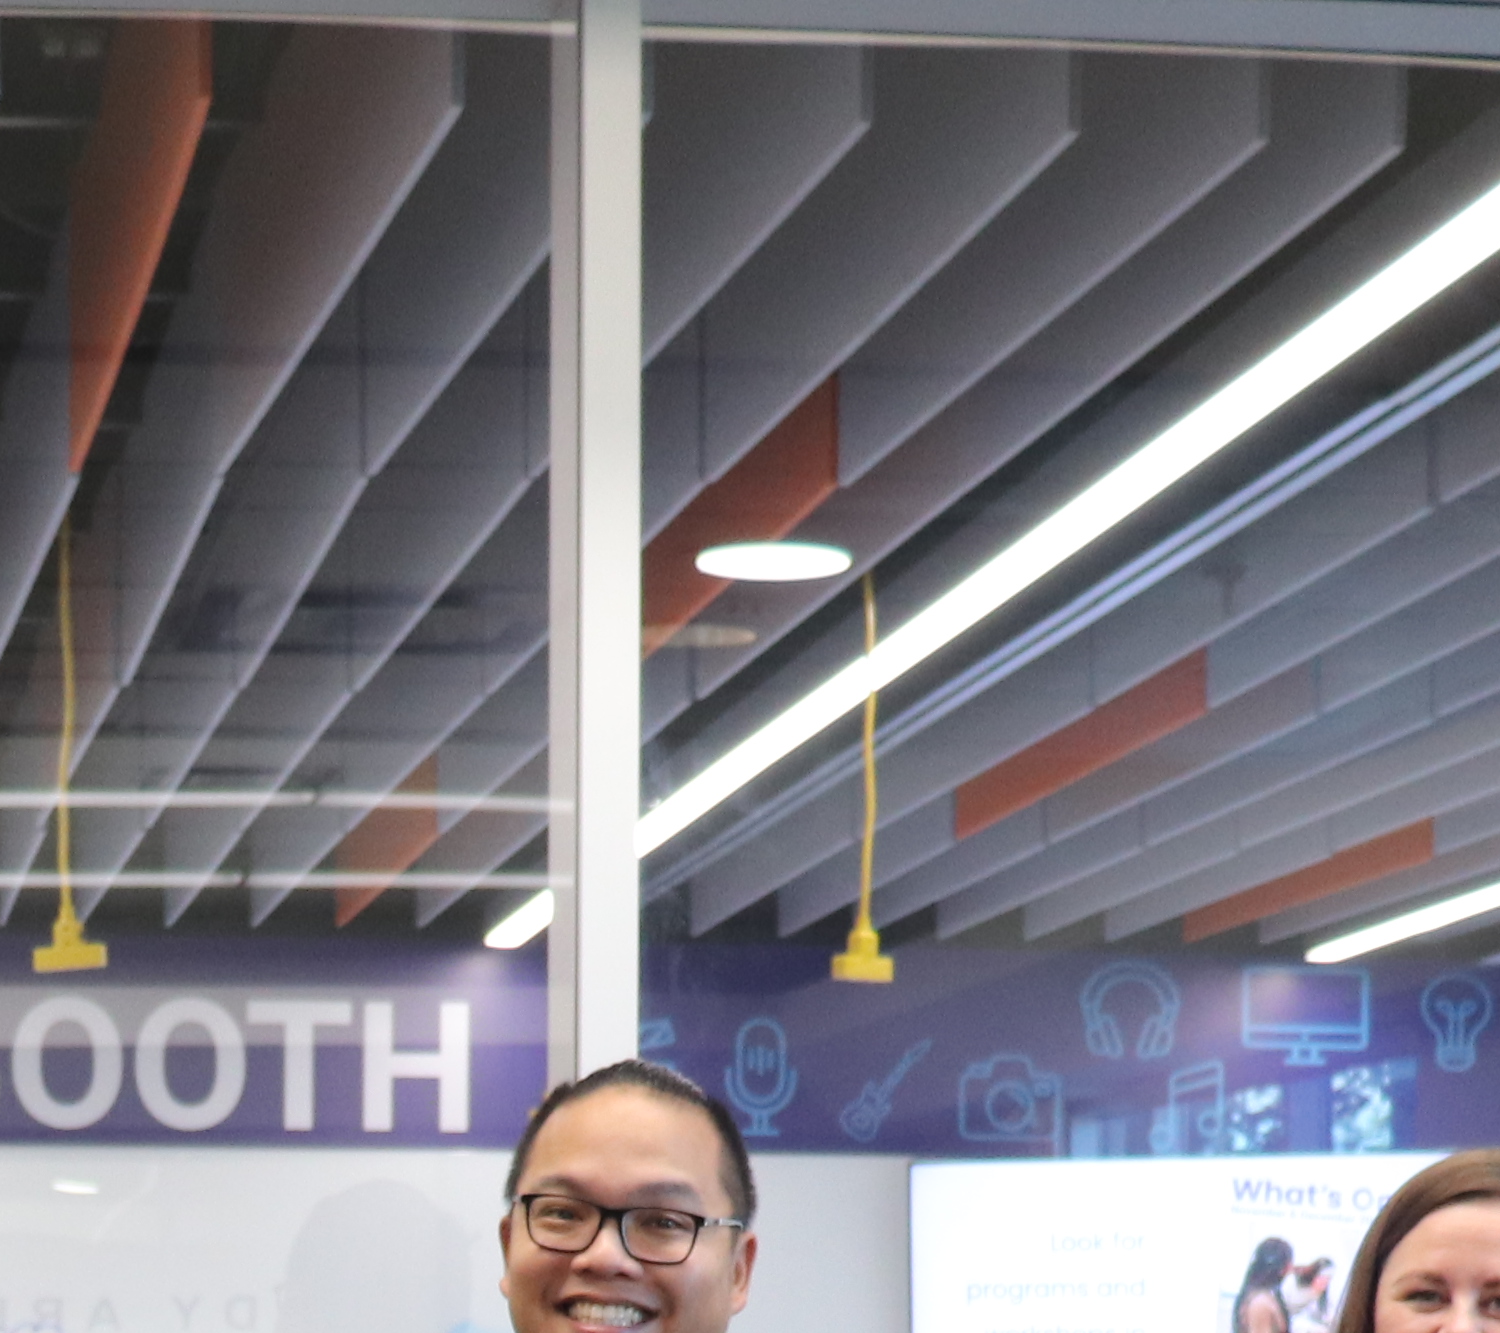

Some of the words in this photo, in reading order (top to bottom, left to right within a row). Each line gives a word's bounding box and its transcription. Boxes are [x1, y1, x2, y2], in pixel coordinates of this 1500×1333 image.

[1233, 1178, 1342, 1210] What's
[1051, 1233, 1103, 1253] Look
[1113, 1231, 1145, 1251] for
[966, 1280, 1088, 1307] programs
[1097, 1278, 1147, 1299] and
